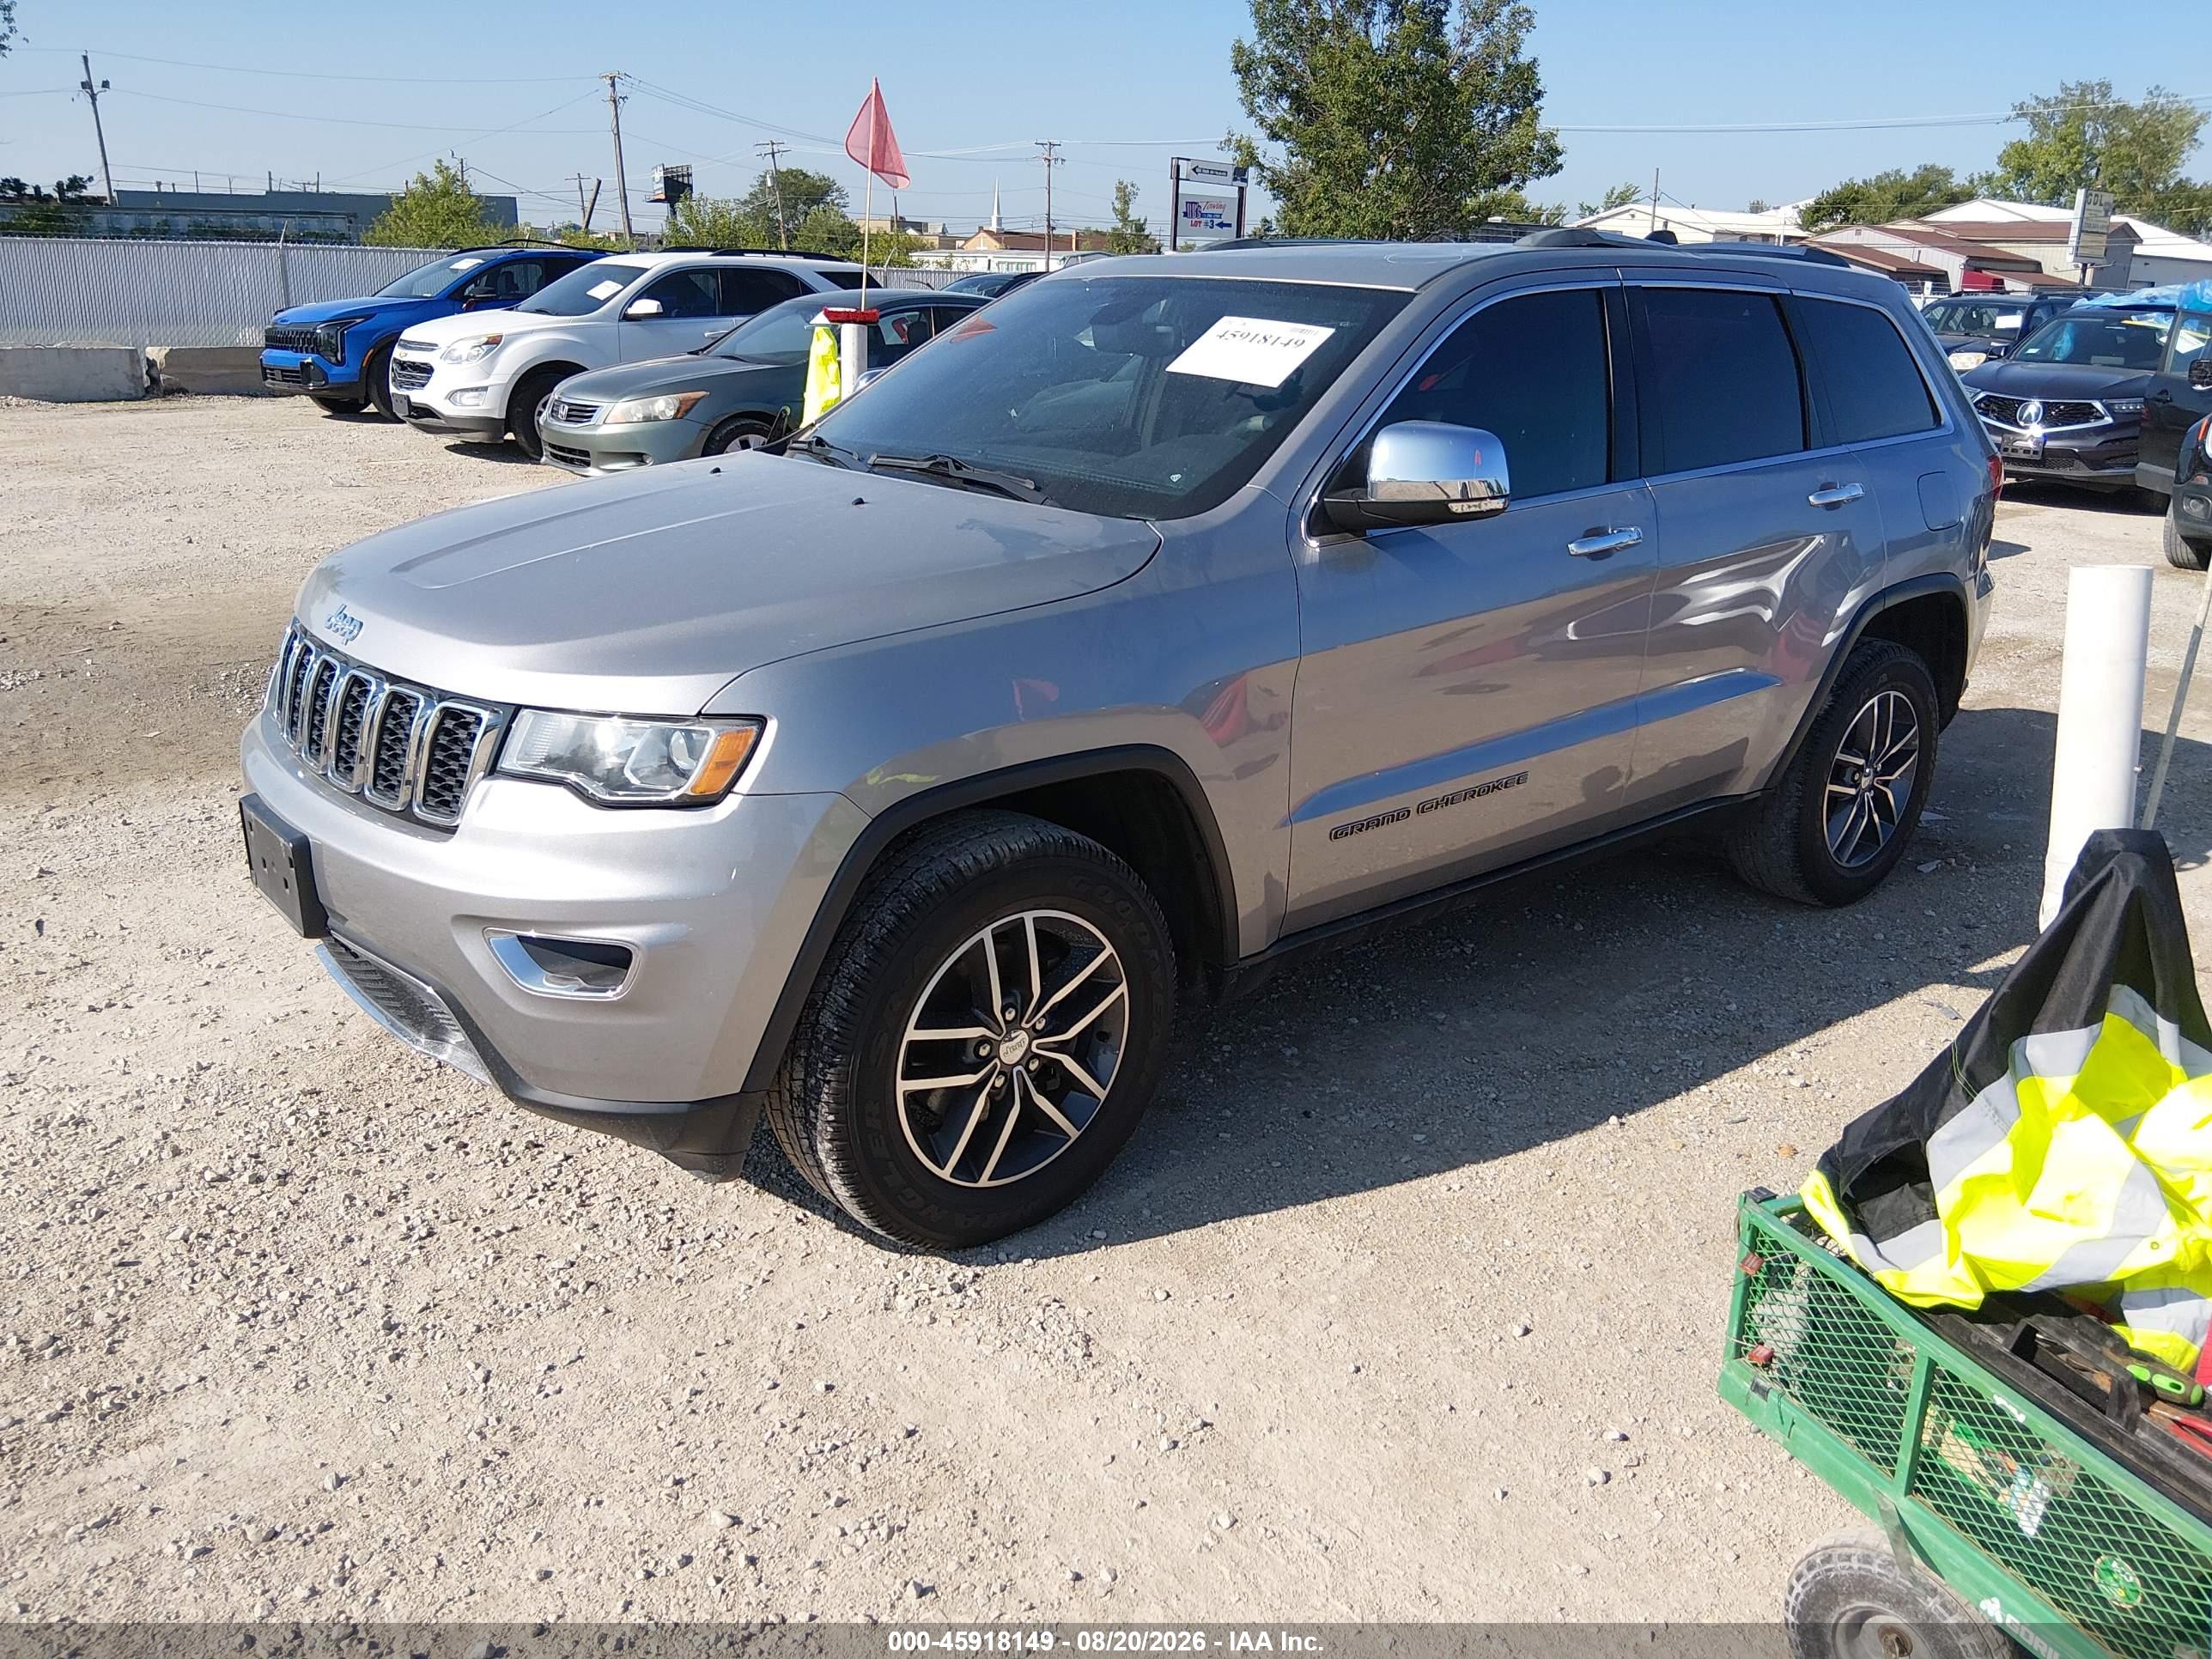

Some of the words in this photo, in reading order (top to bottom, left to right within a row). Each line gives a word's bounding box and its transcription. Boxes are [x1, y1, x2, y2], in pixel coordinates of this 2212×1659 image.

[1203, 219, 1215, 230] #3
[1216, 329, 1306, 349] 45918149
[325, 604, 364, 646] Jeep
[1329, 806, 1413, 842] GRAND
[1417, 771, 1530, 816] CHEROKEE
[1003, 1037, 1025, 1057] Jeep
